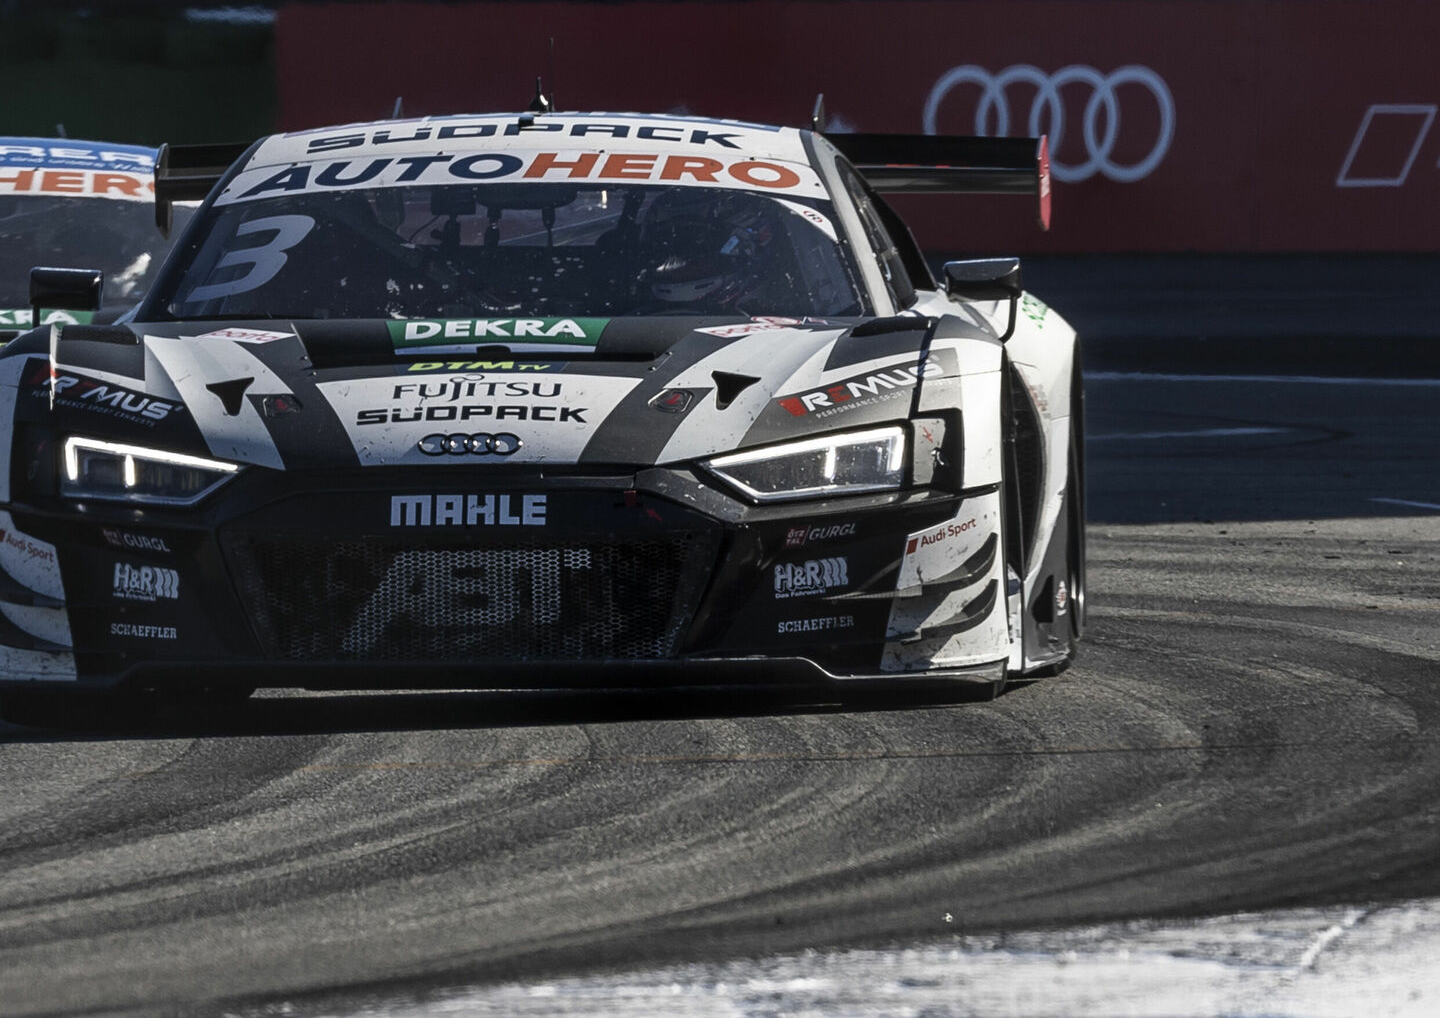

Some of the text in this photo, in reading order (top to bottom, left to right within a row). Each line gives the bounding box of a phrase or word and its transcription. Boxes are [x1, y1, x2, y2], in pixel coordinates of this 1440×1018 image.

[242, 153, 800, 198] AUTOHERO
[185, 215, 315, 302] 3
[405, 319, 587, 341] DEKRA
[408, 361, 515, 372] DTM
[393, 376, 562, 402] FUJITSU
[801, 361, 945, 412] REMUS
[357, 405, 590, 425] SÜDPACK
[390, 494, 547, 526] MAHLE
[123, 533, 171, 552] GURGL
[809, 523, 856, 540] GURGL
[921, 518, 977, 548] Audi Sport
[6, 533, 54, 562] Audi Sport
[113, 562, 155, 592] H&R
[774, 560, 825, 593] H&R
[111, 623, 177, 639] SCHAEFFLER
[778, 615, 855, 633] SCHAEFFLER
